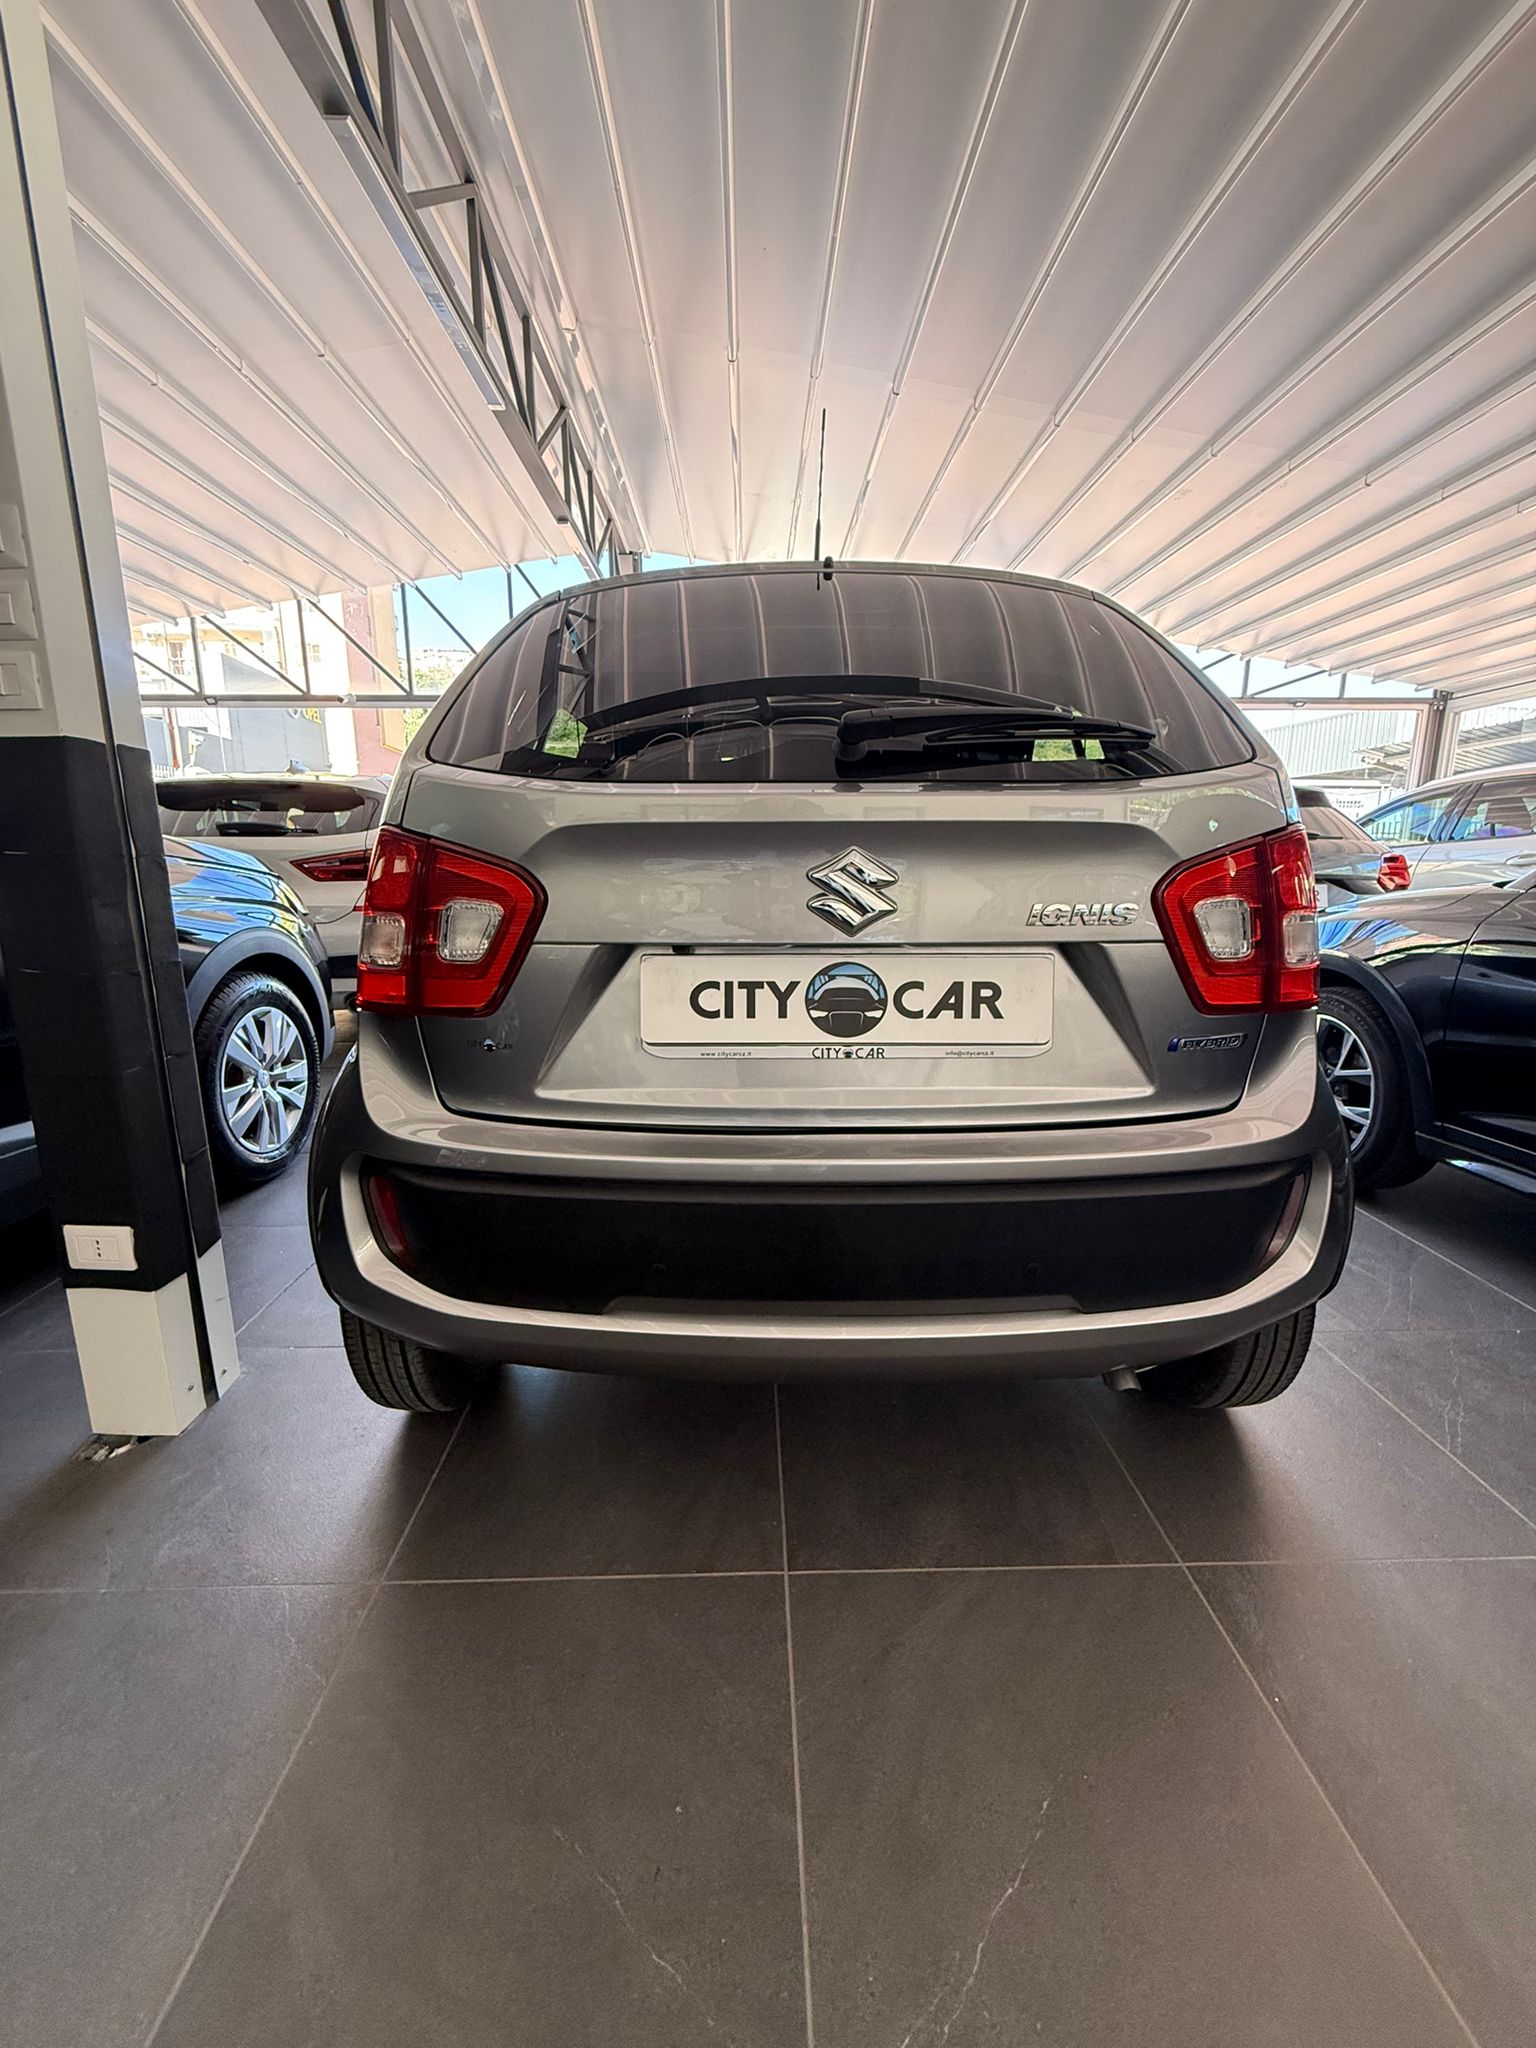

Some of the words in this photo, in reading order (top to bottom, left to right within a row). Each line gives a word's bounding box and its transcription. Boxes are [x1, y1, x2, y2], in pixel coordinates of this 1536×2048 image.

[1026, 902, 1140, 926] IGNIS
[689, 980, 801, 1020] CITY
[892, 980, 1004, 1020] CAR
[1182, 1037, 1241, 1050] HYBRID
[812, 1047, 841, 1059] CITY
[855, 1047, 885, 1059] CAR
